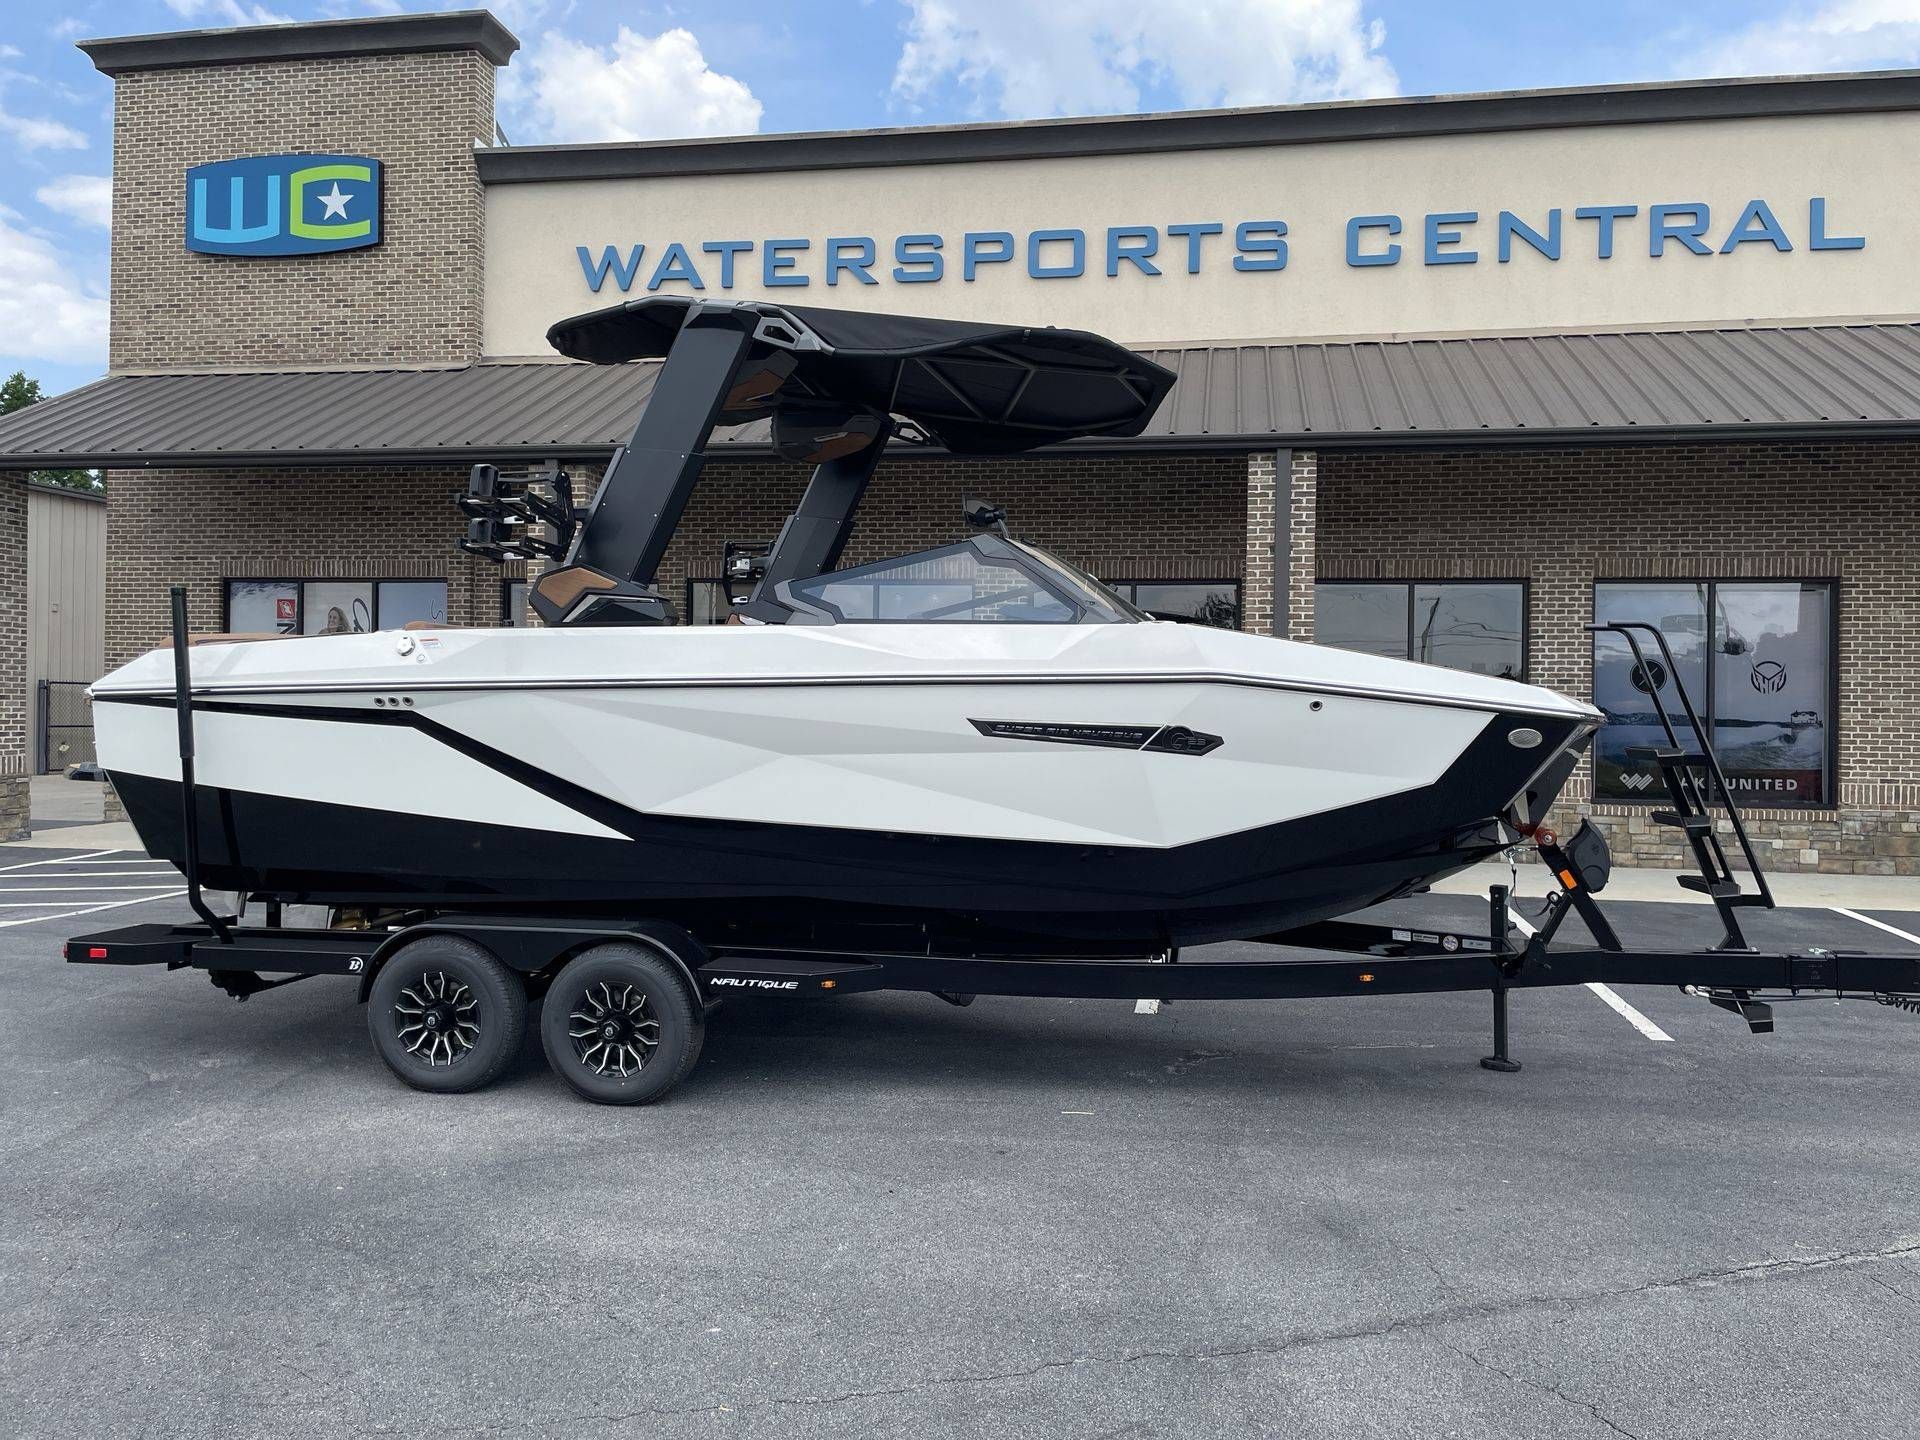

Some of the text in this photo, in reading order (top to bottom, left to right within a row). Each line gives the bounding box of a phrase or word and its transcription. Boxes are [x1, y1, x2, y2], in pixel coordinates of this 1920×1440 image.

[576, 197, 1866, 293] WATERSPORTS CENTRAL
[1726, 778, 1798, 791] UNITED
[710, 977, 799, 990] NAUTIQUE
